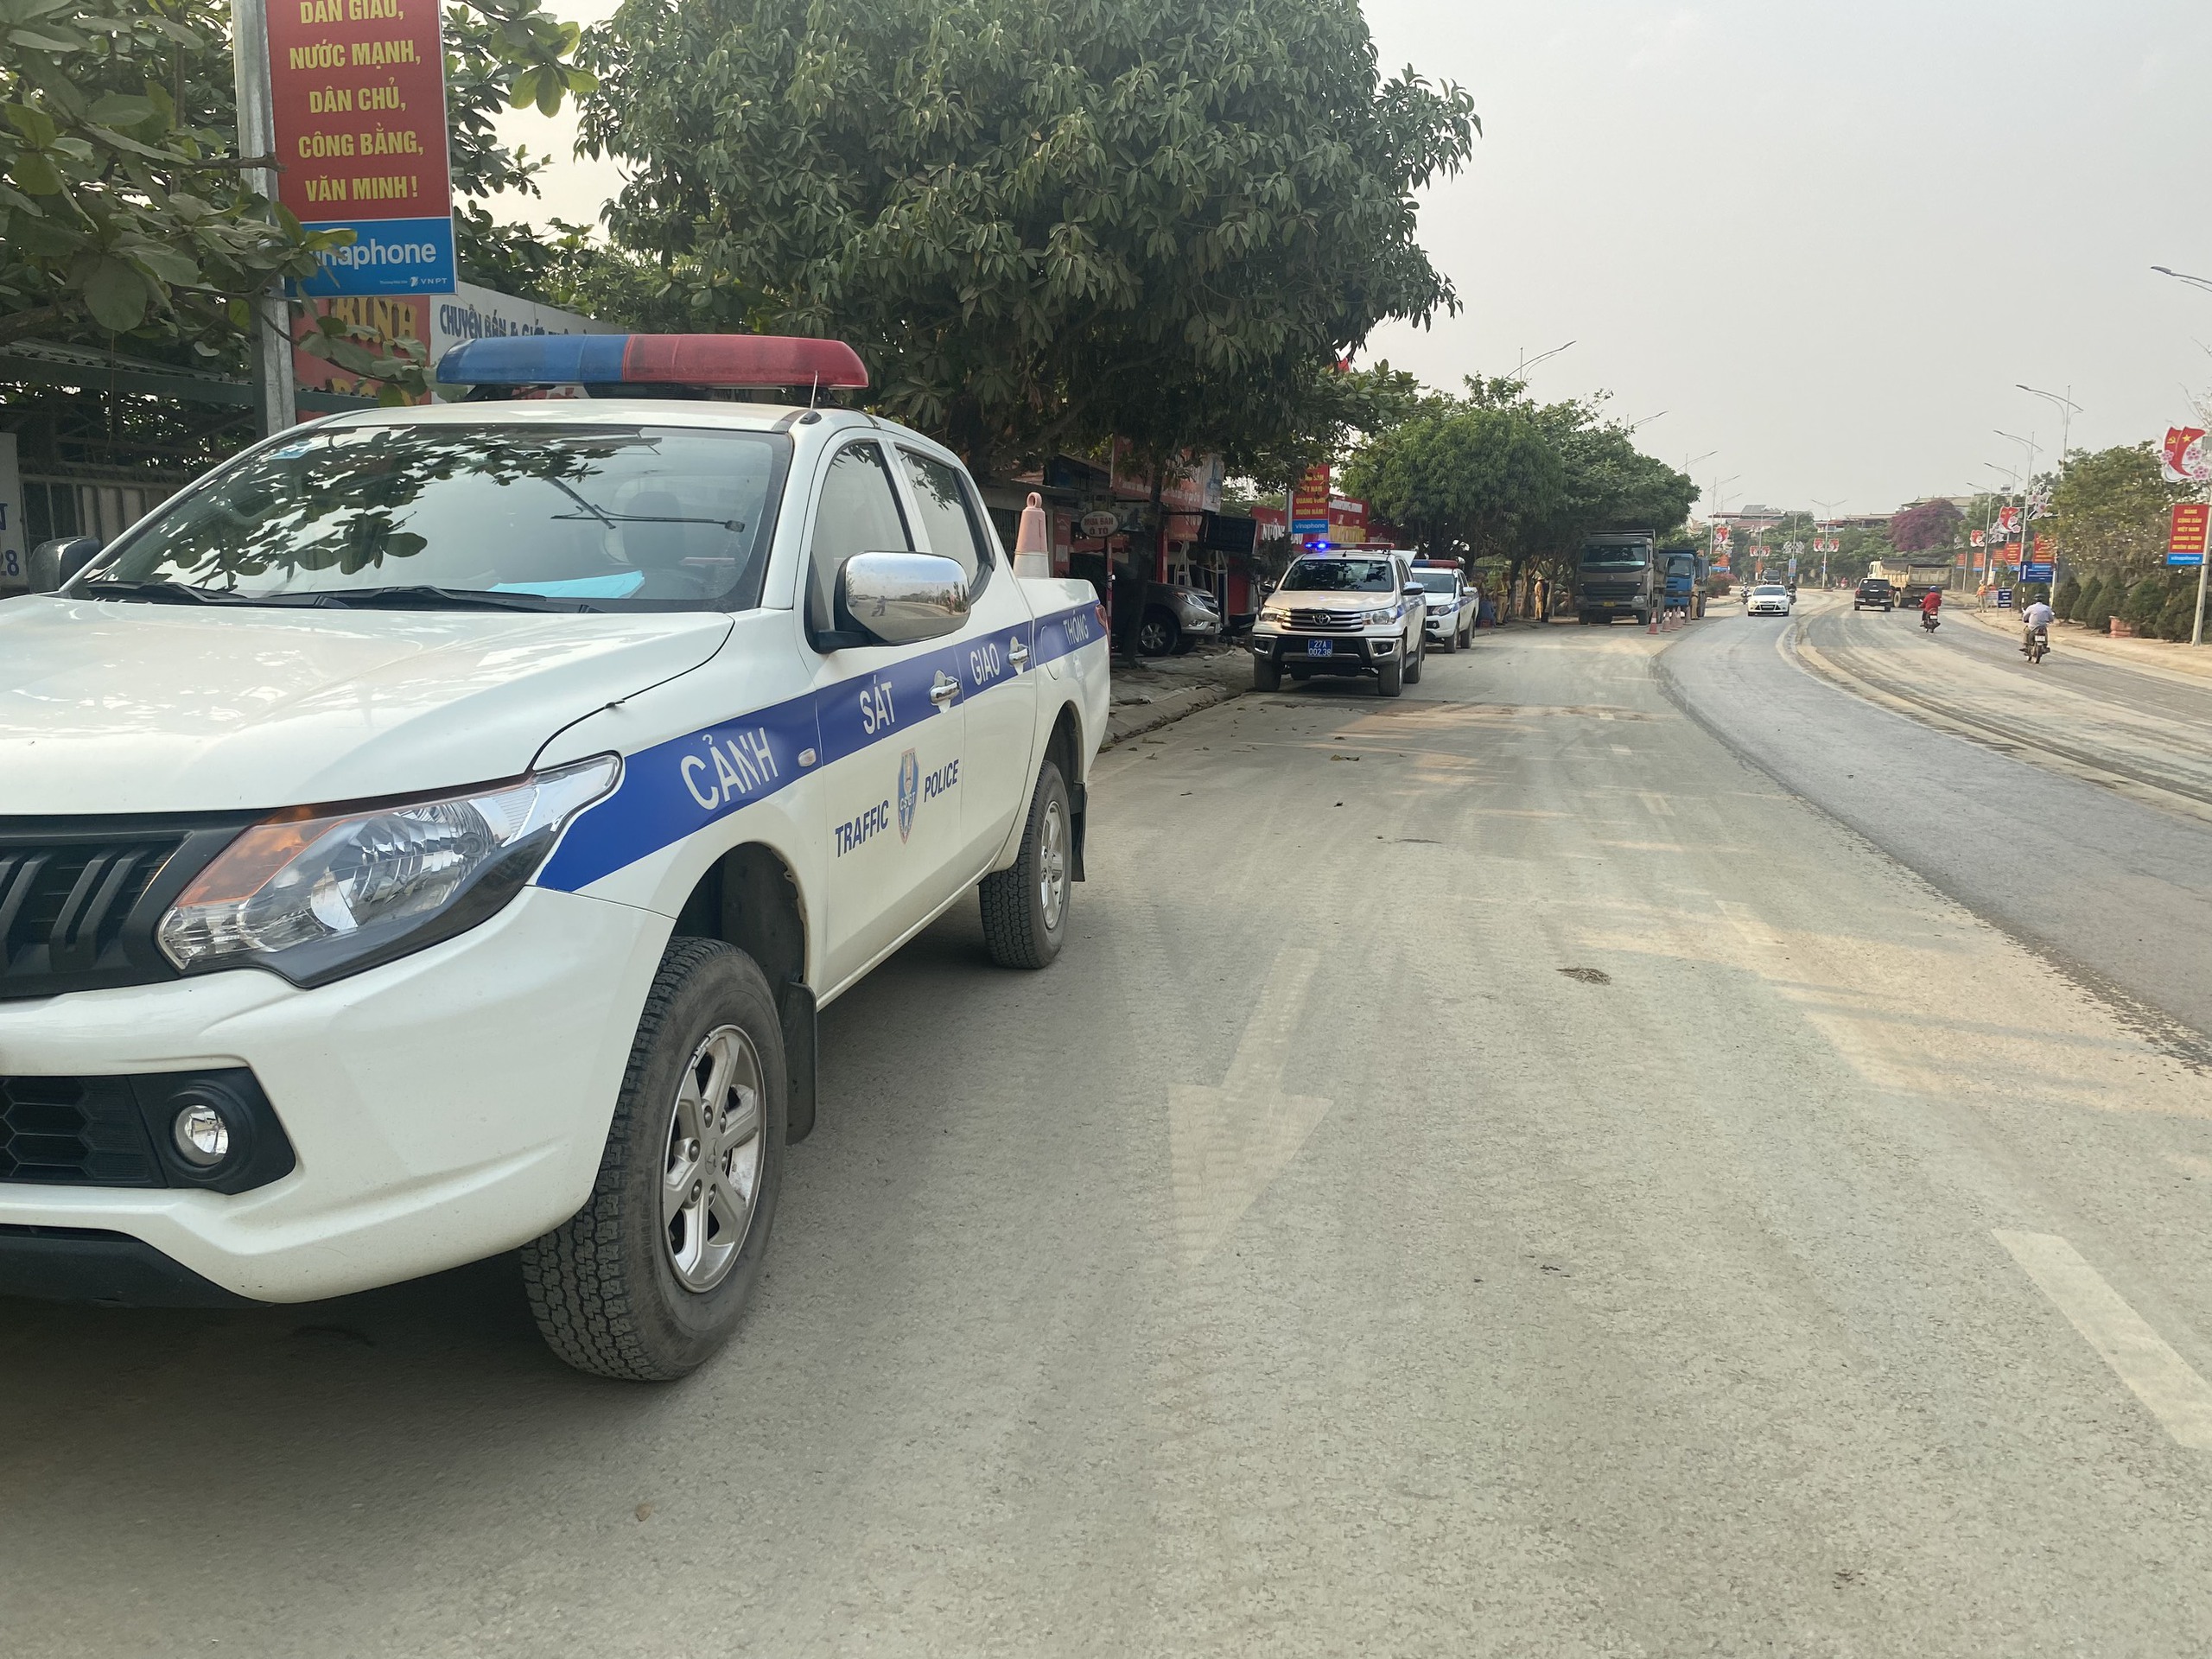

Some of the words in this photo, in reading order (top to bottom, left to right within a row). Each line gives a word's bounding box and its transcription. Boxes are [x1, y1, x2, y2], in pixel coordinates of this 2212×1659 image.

[289, 39, 346, 70] NƯỚC
[352, 40, 422, 70] MẠNH,
[309, 86, 353, 113] DÂN
[358, 77, 406, 111] CHỦ,
[298, 131, 355, 158] CÔNG
[359, 122, 424, 156] BẰNG,
[305, 175, 346, 202] VĂN
[680, 727, 779, 810] CẢNH
[859, 675, 895, 734] SÁT
[970, 643, 1001, 685] GIAO
[835, 799, 889, 858] TRAFFIC
[924, 759, 959, 803] POLICE
